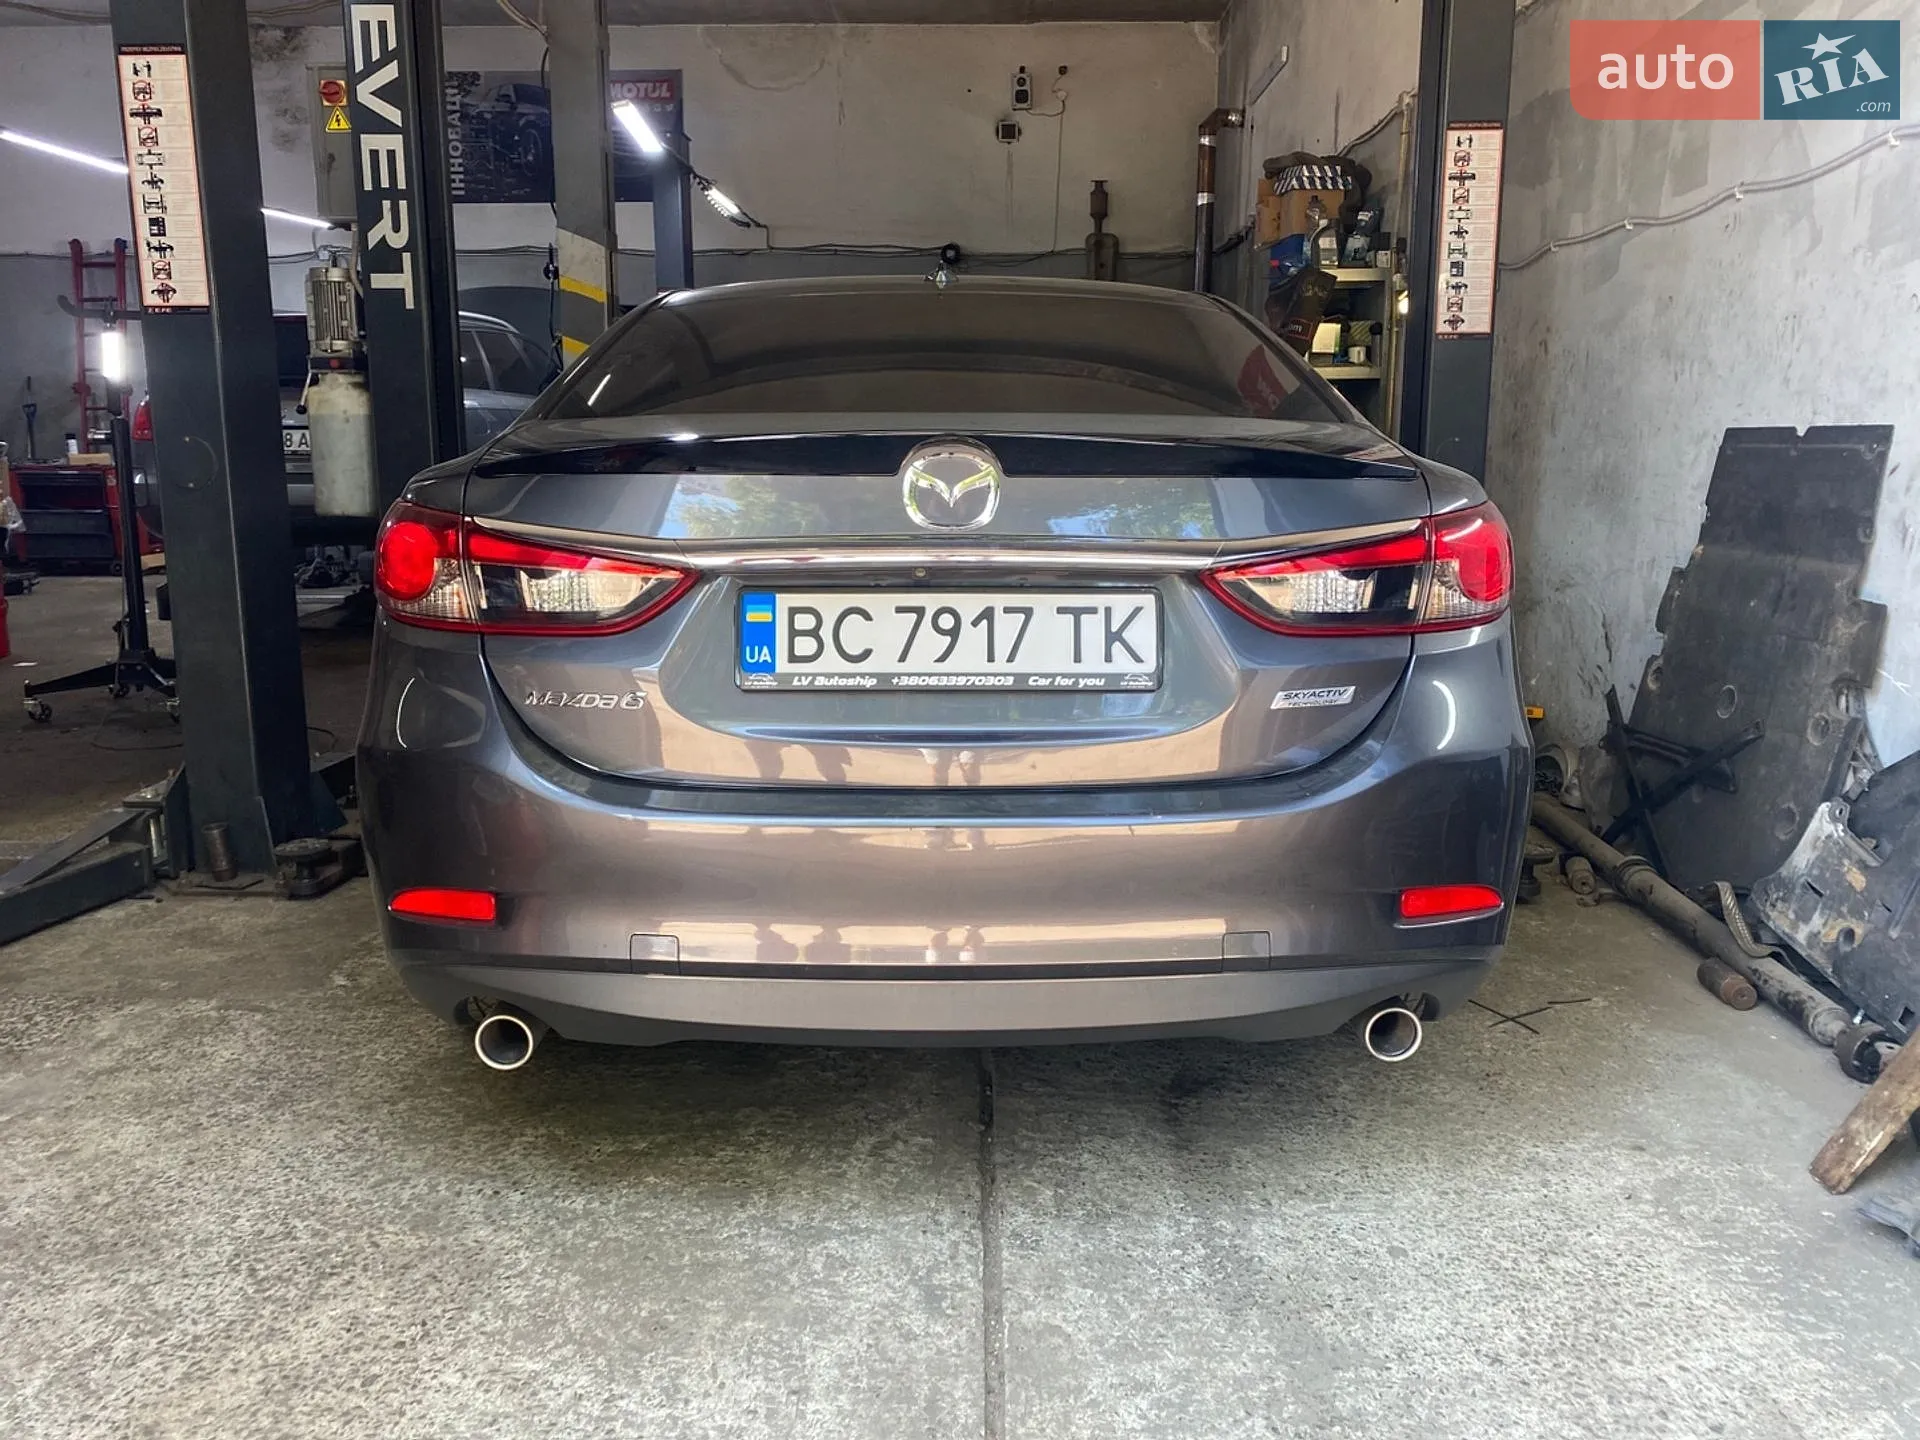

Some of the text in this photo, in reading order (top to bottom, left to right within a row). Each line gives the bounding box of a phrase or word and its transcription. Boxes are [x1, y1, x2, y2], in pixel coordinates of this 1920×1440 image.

[350, 4, 415, 310] EVERT
[787, 606, 1145, 664] BC 7917 TK
[746, 646, 772, 664] UA
[792, 675, 813, 686] LV
[1028, 675, 1052, 686] Car
[1053, 675, 1076, 686] for
[1077, 677, 1105, 688] you
[1282, 688, 1349, 700] SKYACTIV
